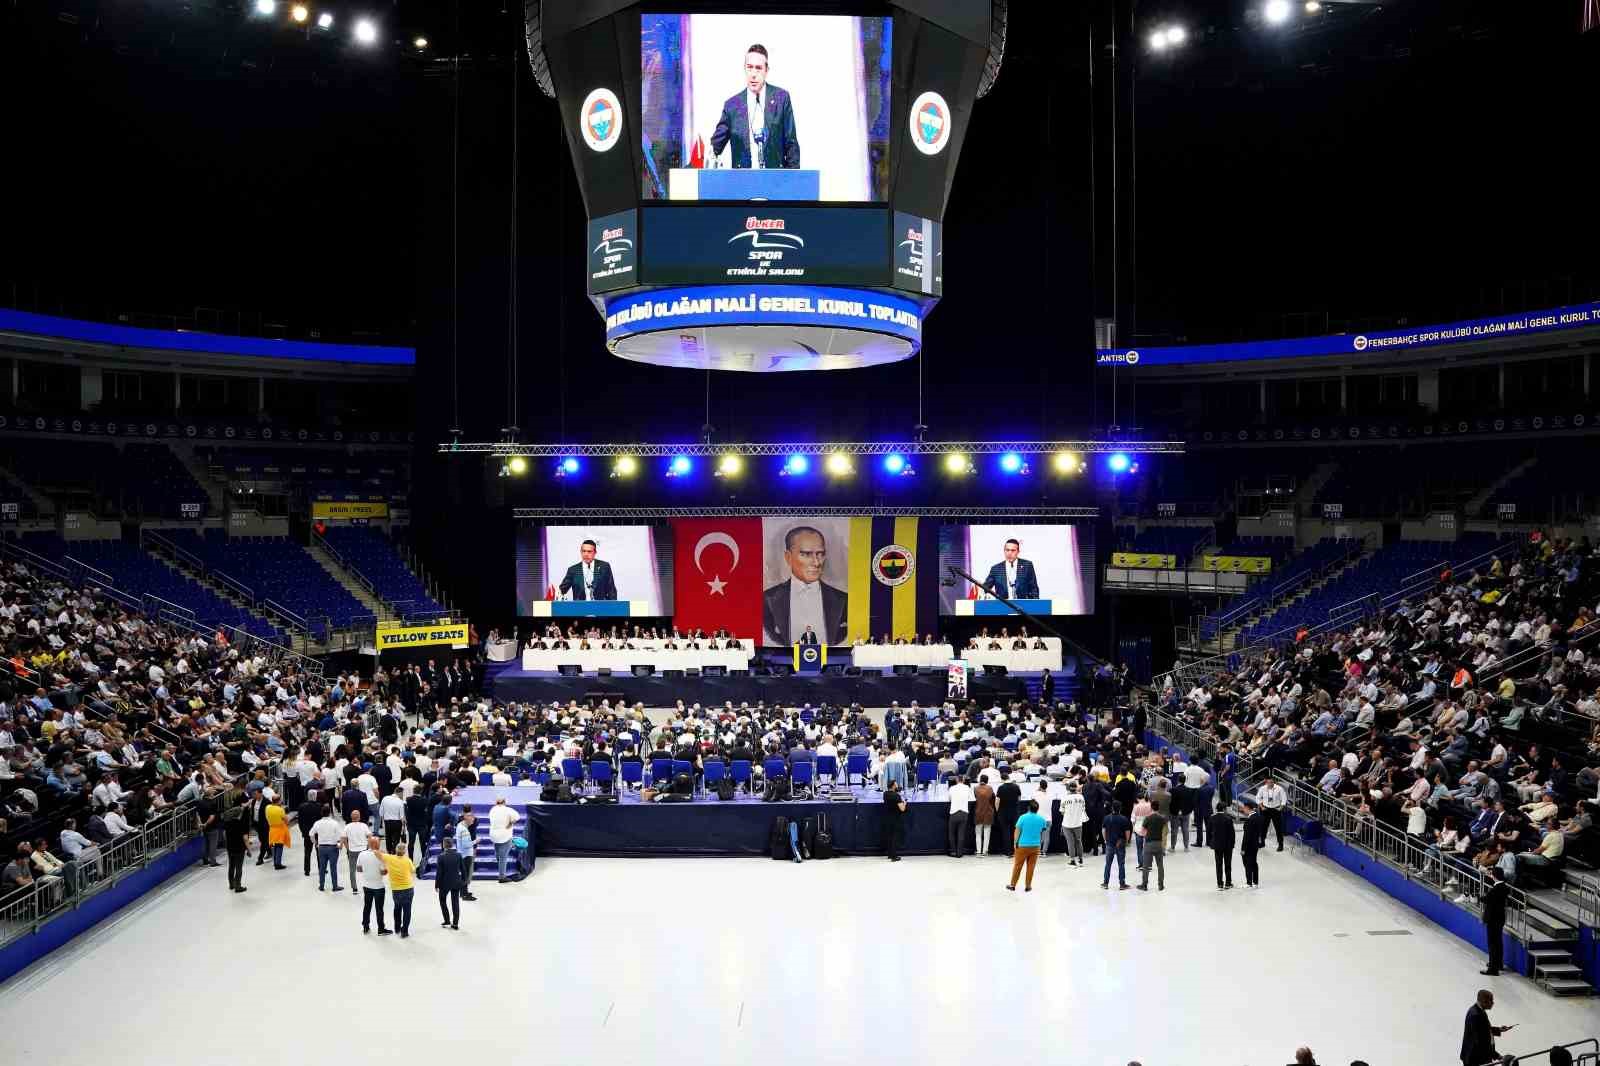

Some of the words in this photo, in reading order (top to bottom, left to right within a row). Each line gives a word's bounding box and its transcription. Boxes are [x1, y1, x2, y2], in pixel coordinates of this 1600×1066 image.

[745, 216, 785, 230] ÜLKER
[748, 251, 783, 260] SPOR
[654, 297, 711, 318] OLAĞAN
[714, 294, 756, 313] MALİ
[758, 297, 815, 313] GENEL
[817, 299, 867, 318] KURUL
[1368, 335, 1418, 347] FENERBAHÇE
[1420, 332, 1440, 342] SPOR
[1441, 326, 1472, 339] KULÜBÜ
[1507, 317, 1528, 331] MALİ
[1529, 316, 1558, 328] GENEL
[1560, 311, 1590, 324] KURUL
[382, 632, 427, 644] YELLOW
[430, 630, 464, 641] SEATS
